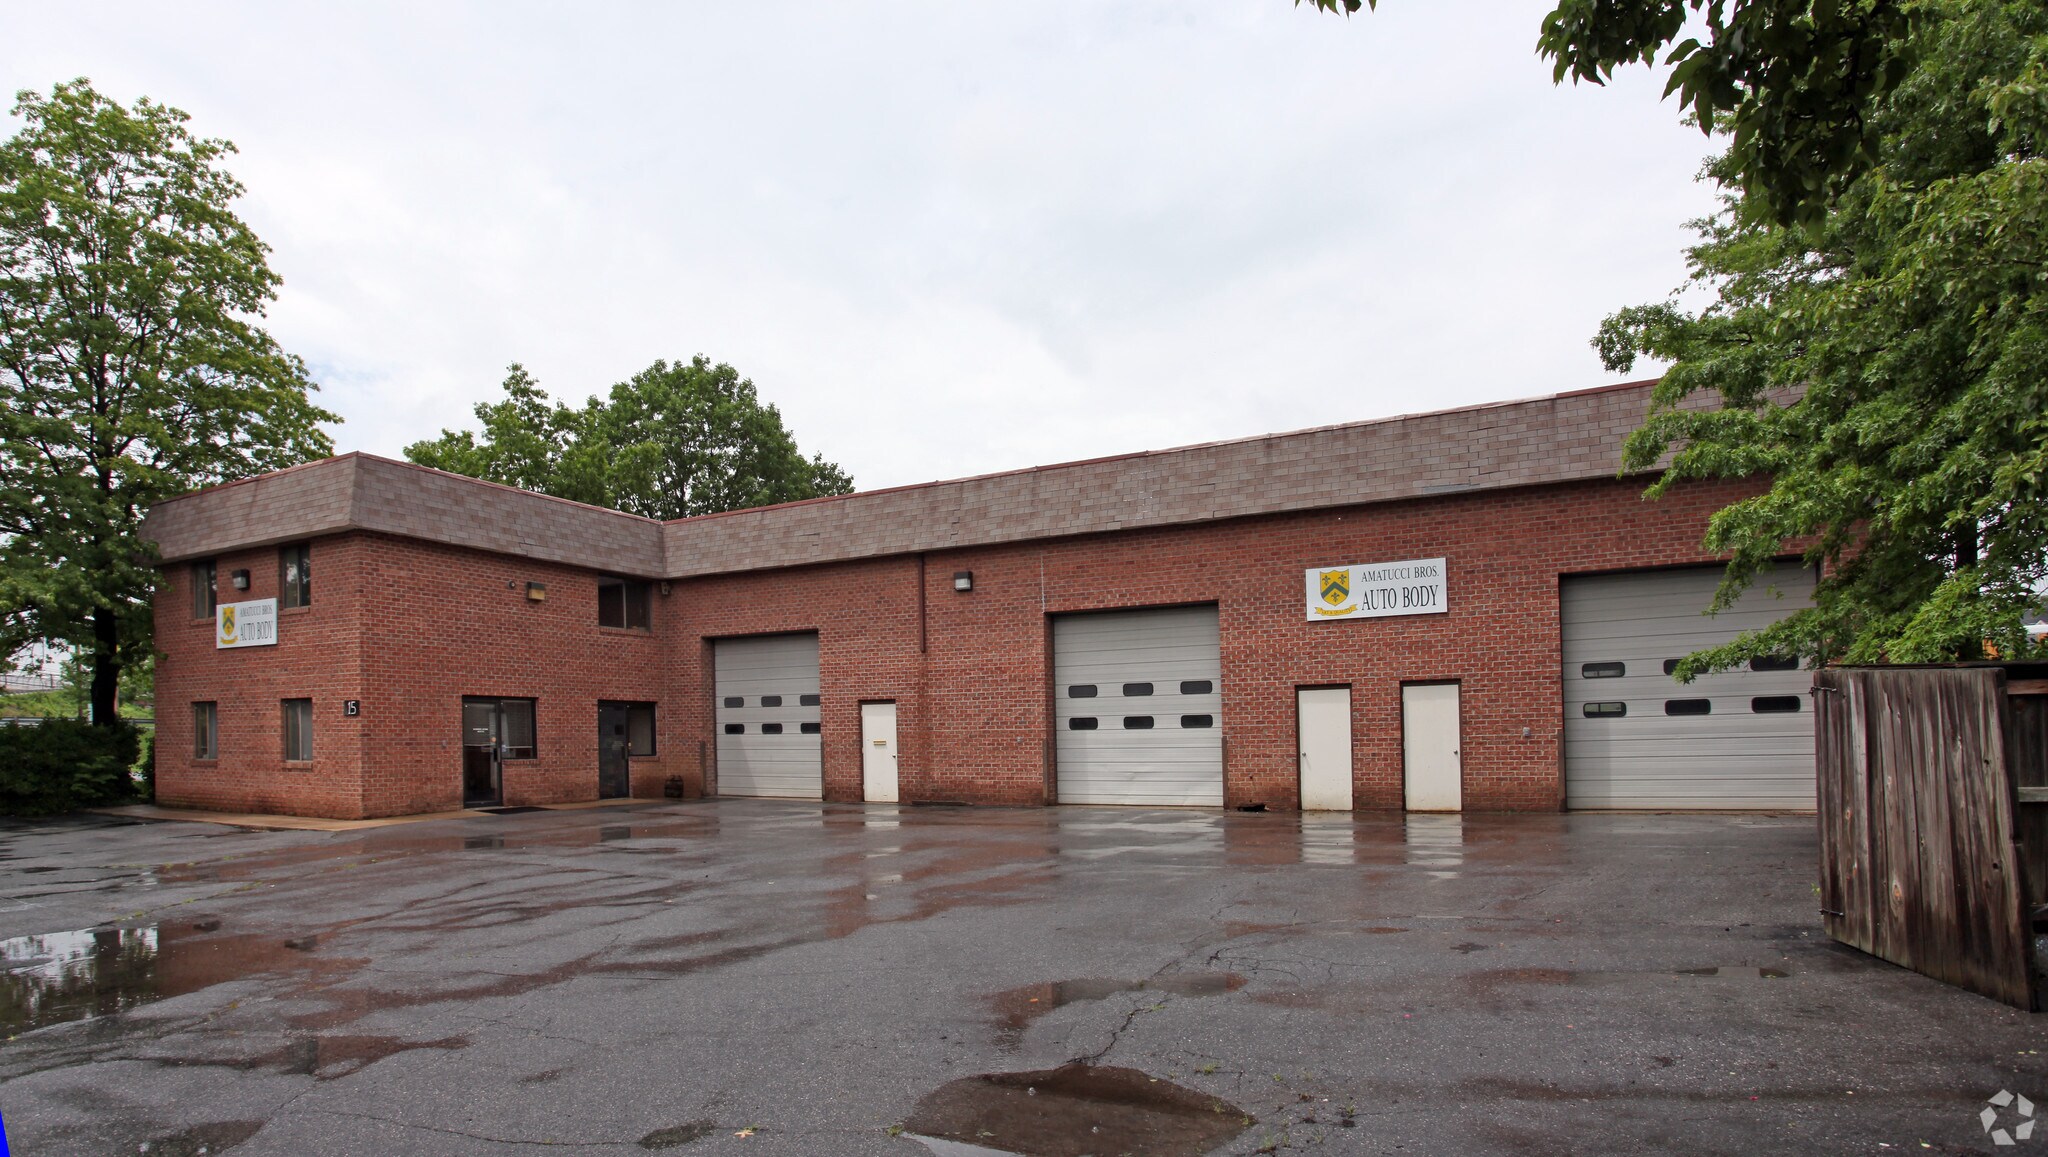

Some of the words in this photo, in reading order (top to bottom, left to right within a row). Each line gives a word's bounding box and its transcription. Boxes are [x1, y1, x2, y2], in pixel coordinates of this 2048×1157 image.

[1361, 567, 1410, 582] AMATUCCI
[1414, 565, 1439, 579] BROS.
[1361, 587, 1397, 611] AUTO
[1402, 584, 1439, 608] BODY
[240, 622, 256, 641] AUTO
[256, 620, 273, 640] BODY
[347, 701, 357, 715] 15
